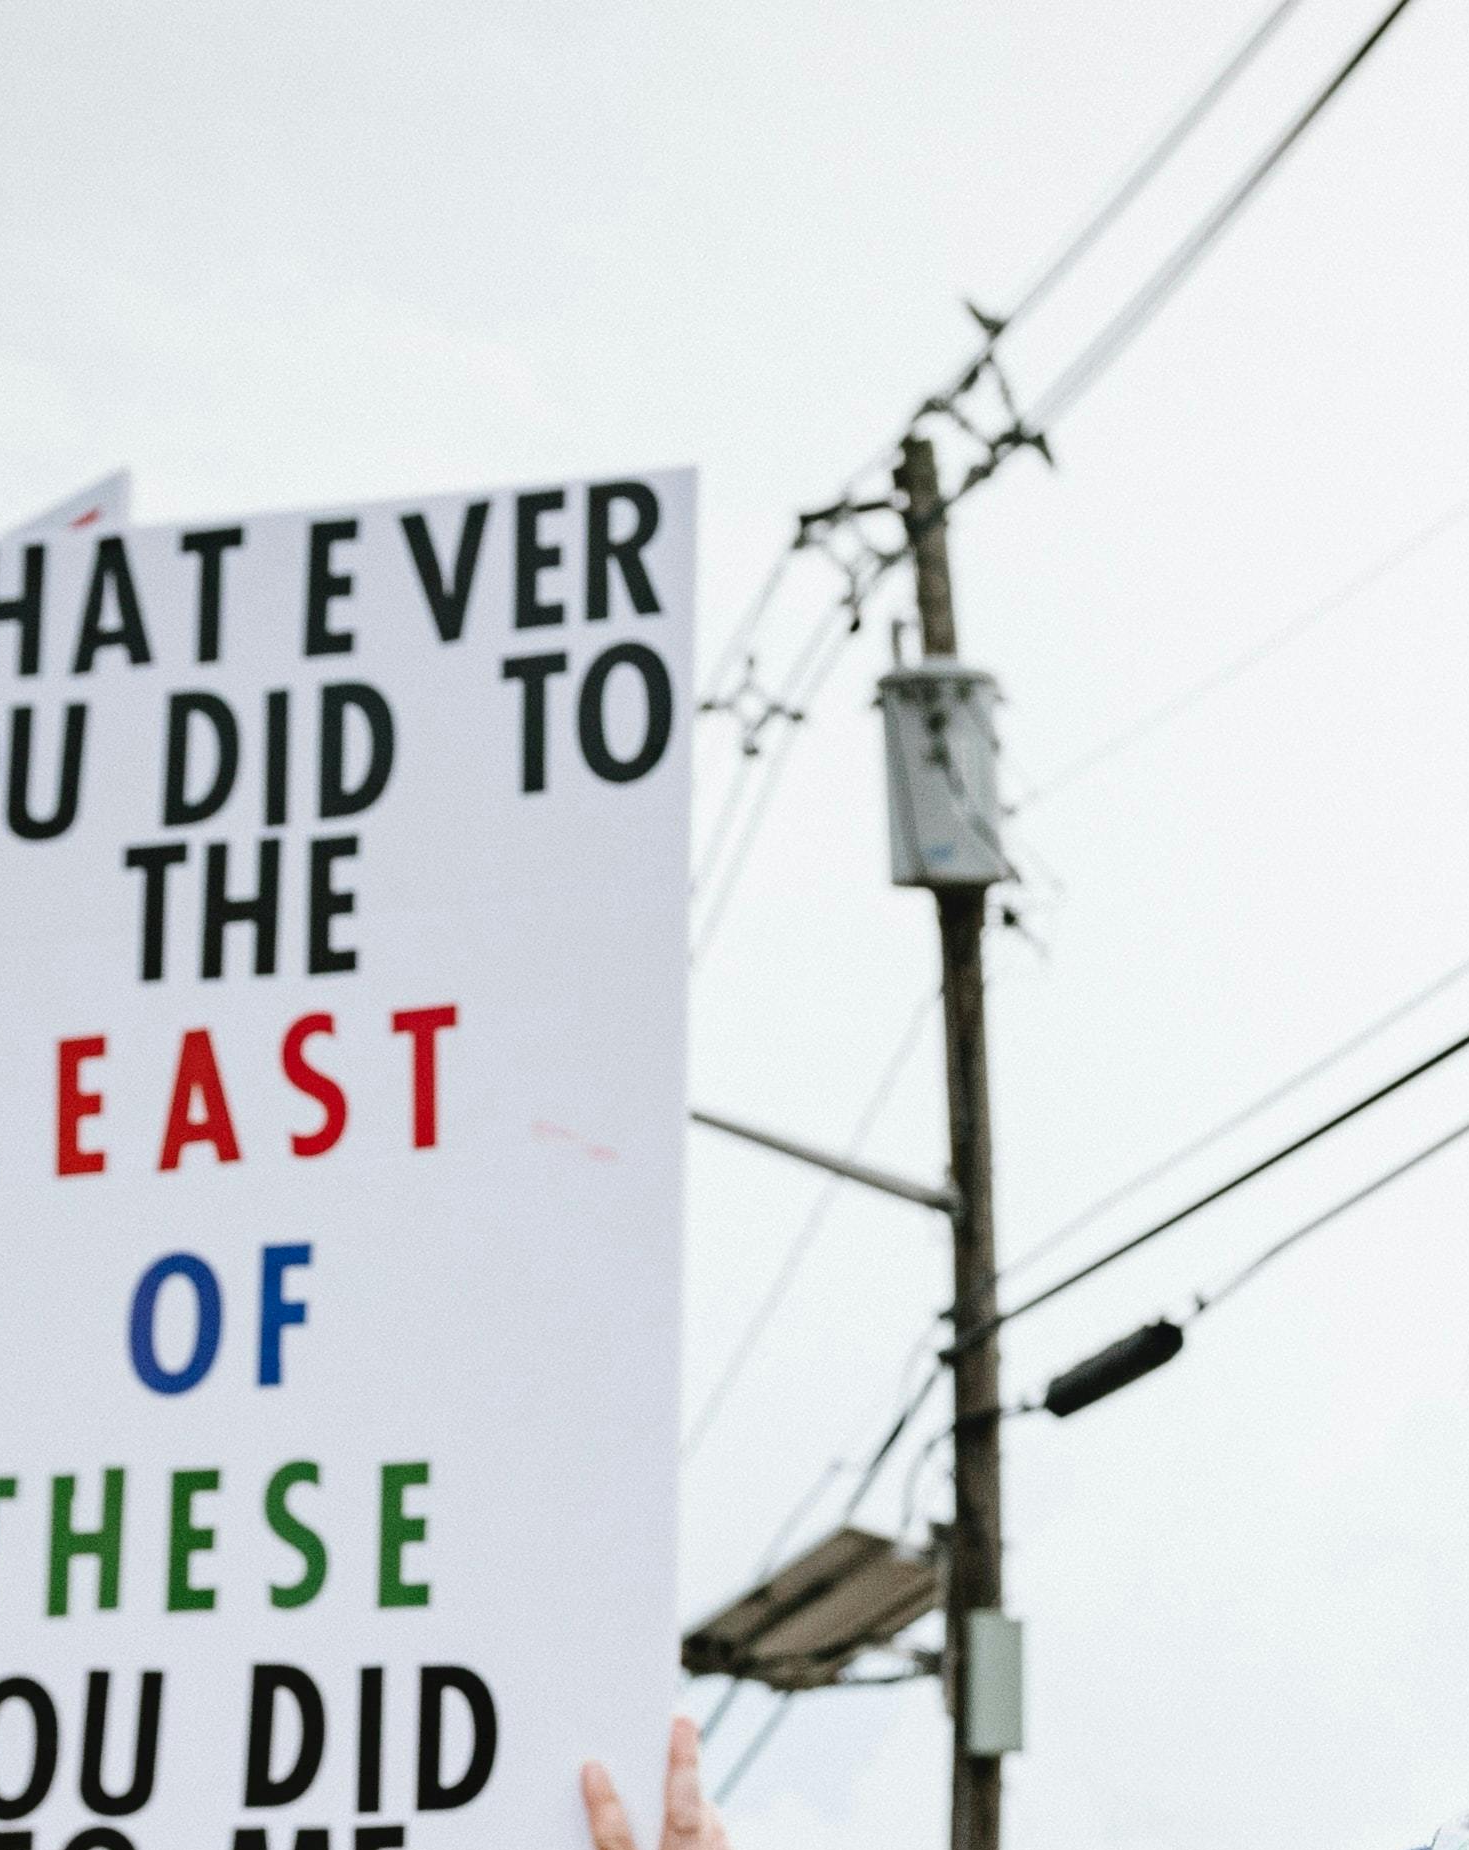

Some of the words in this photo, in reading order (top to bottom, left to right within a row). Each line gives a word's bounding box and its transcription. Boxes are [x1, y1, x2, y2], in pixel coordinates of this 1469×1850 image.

[161, 681, 396, 828] DID
[501, 640, 674, 796] TO
[123, 834, 360, 982] THE
[127, 1240, 314, 1396] OF
[242, 1663, 499, 1813] DID
